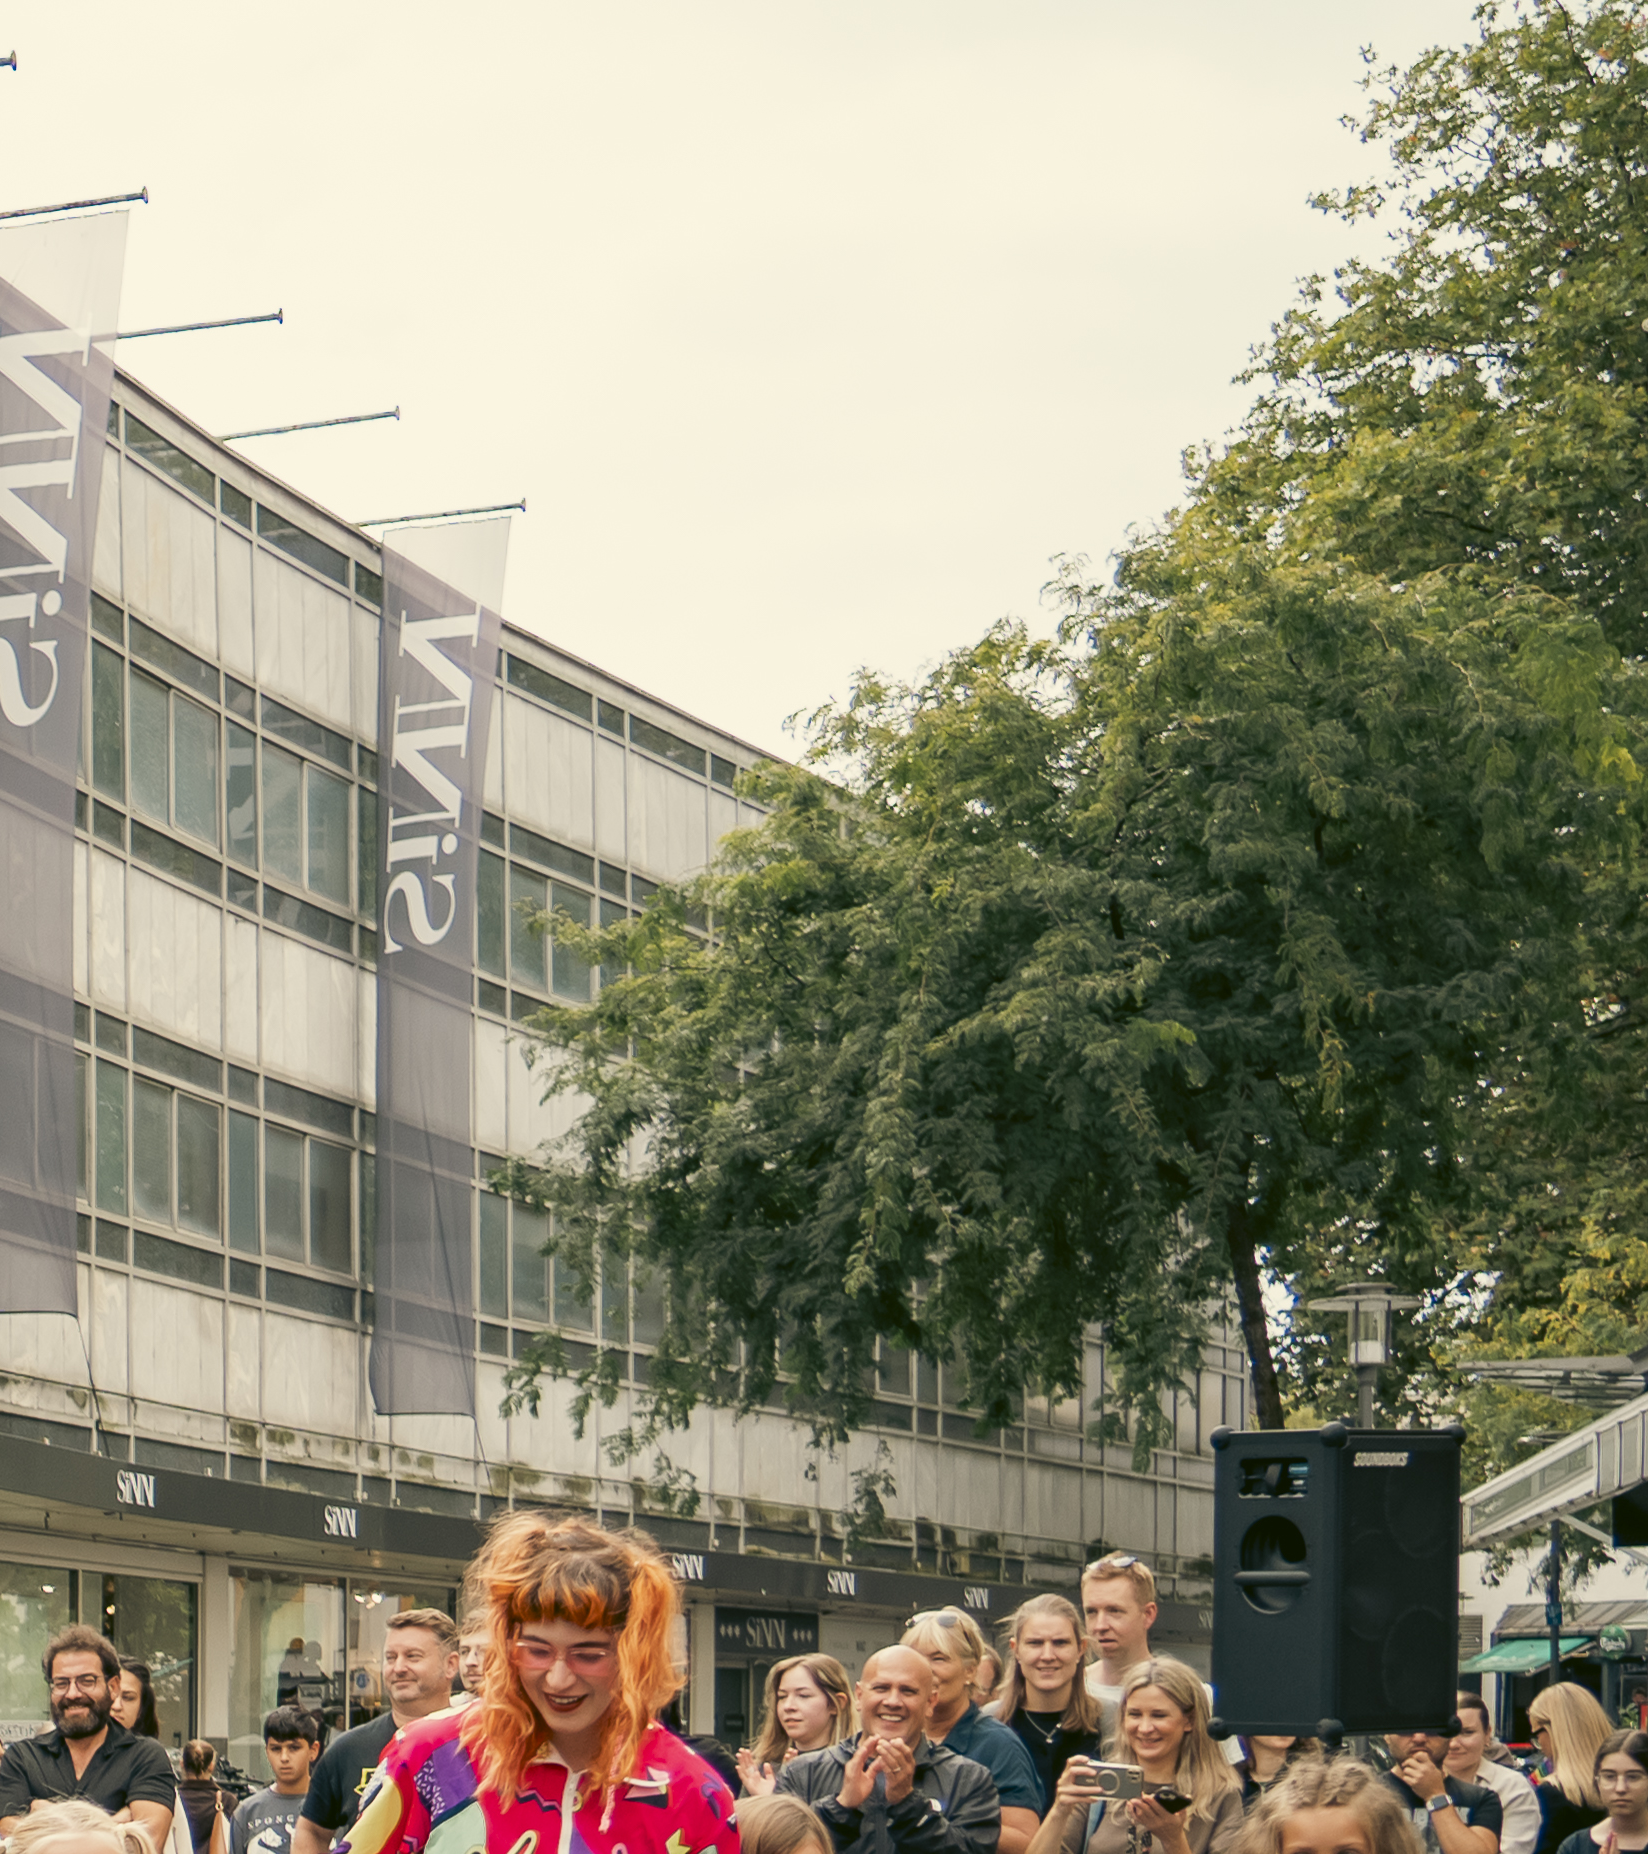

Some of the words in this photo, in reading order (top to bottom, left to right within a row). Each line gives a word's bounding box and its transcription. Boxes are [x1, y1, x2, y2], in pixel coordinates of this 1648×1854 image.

[116, 1469, 155, 1508] SiNN
[323, 1505, 357, 1538] SiNN
[827, 1569, 856, 1596] SiNN
[746, 1616, 786, 1649] SiNN
[247, 1813, 295, 1830] SPONG
